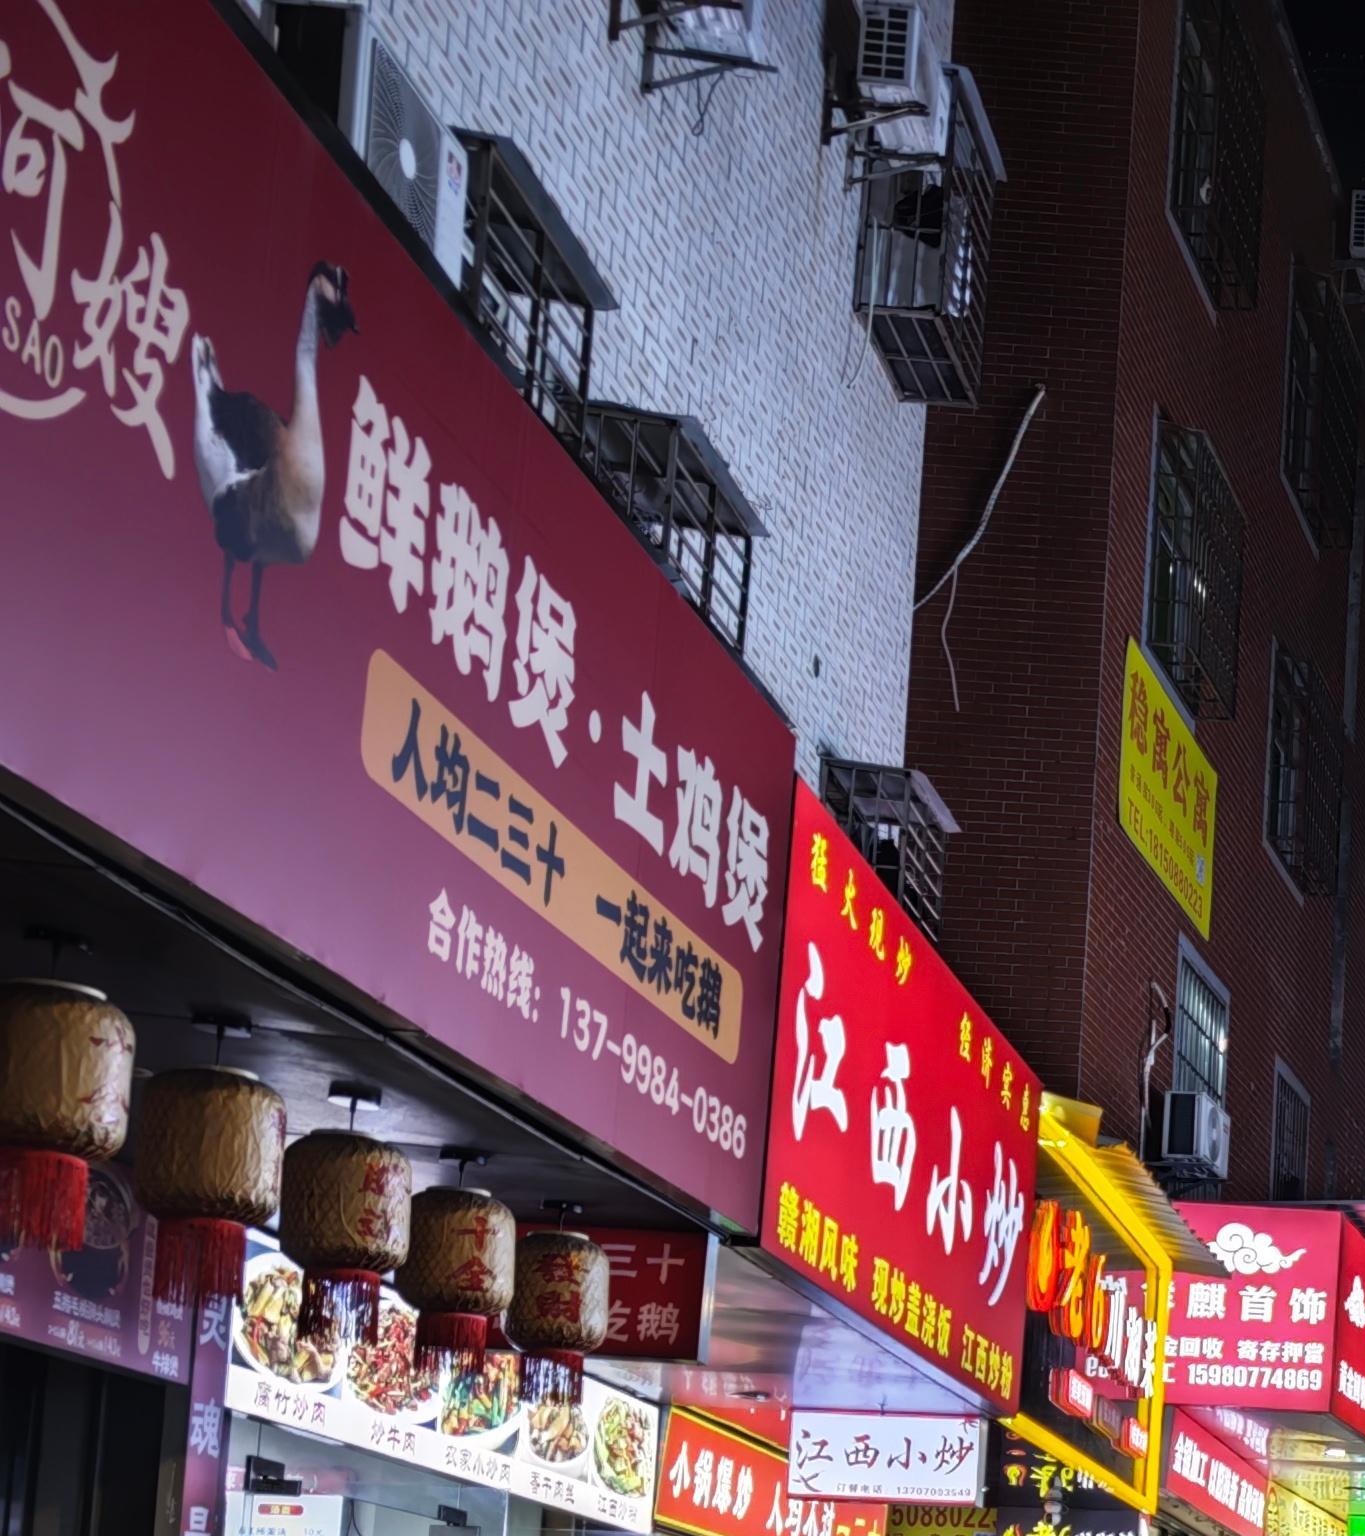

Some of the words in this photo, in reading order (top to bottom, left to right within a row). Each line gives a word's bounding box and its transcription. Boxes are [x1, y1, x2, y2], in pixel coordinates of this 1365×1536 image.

[391, 697, 566, 907] 人均二三十
[595, 890, 724, 1040] 一起来吃鹅
[811, 833, 912, 984] 猛火现炒
[959, 1012, 1030, 1131] 经济实惠
[559, 988, 747, 1159] 137-9984-0386
[792, 942, 1024, 1307] 江西小炒
[777, 1183, 858, 1293] 赣湘风味
[872, 1257, 951, 1361] 现炒盖浇饭
[961, 1325, 1013, 1401] 江西炒粉
[1188, 1363, 1323, 1391] 15980774869
[669, 1441, 754, 1521] 小锅爆炒
[795, 1429, 975, 1476] 江西小炒
[891, 1504, 997, 1529] 5088022
